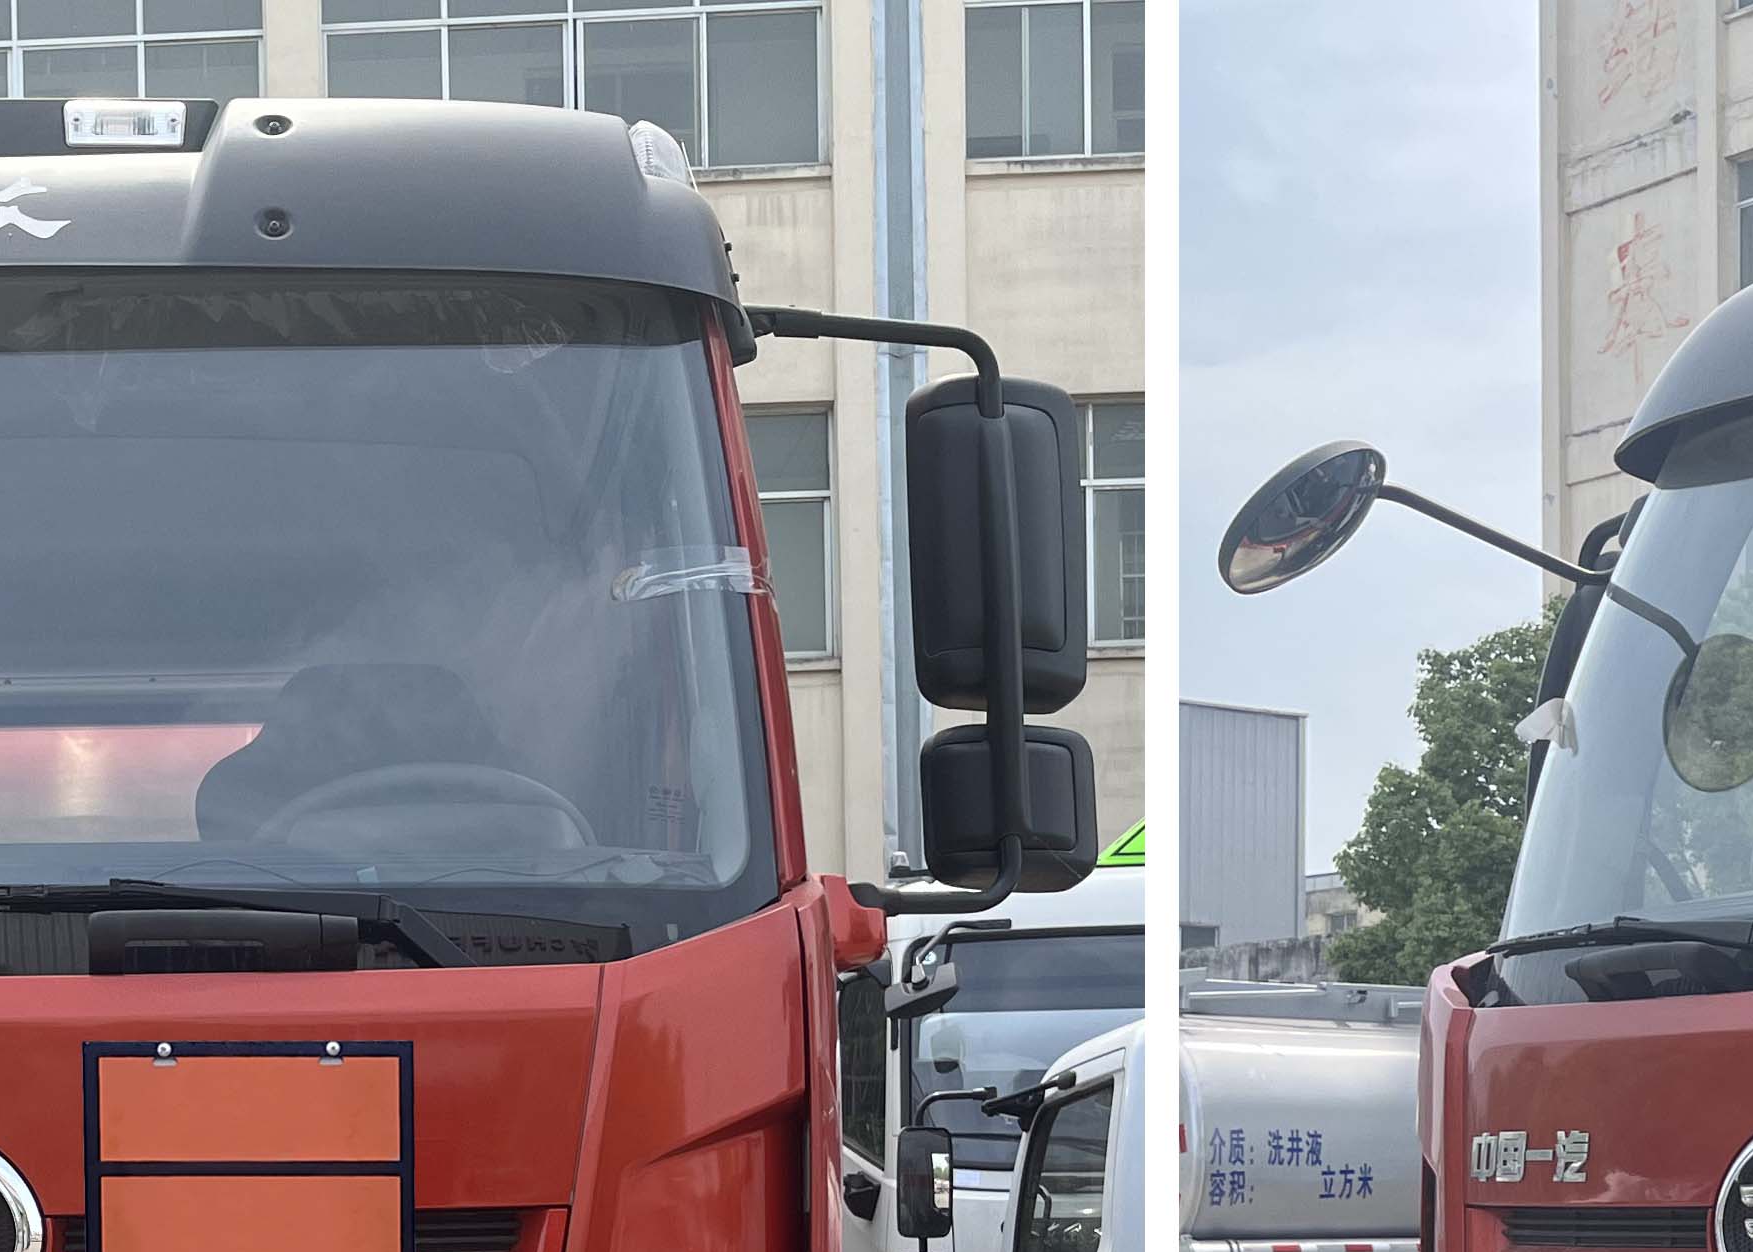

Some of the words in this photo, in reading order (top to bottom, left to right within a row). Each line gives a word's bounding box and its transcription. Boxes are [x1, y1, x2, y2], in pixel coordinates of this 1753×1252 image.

[1470, 1130, 1590, 1183] 中国一汽
[1317, 1162, 1375, 1200] 立方米
